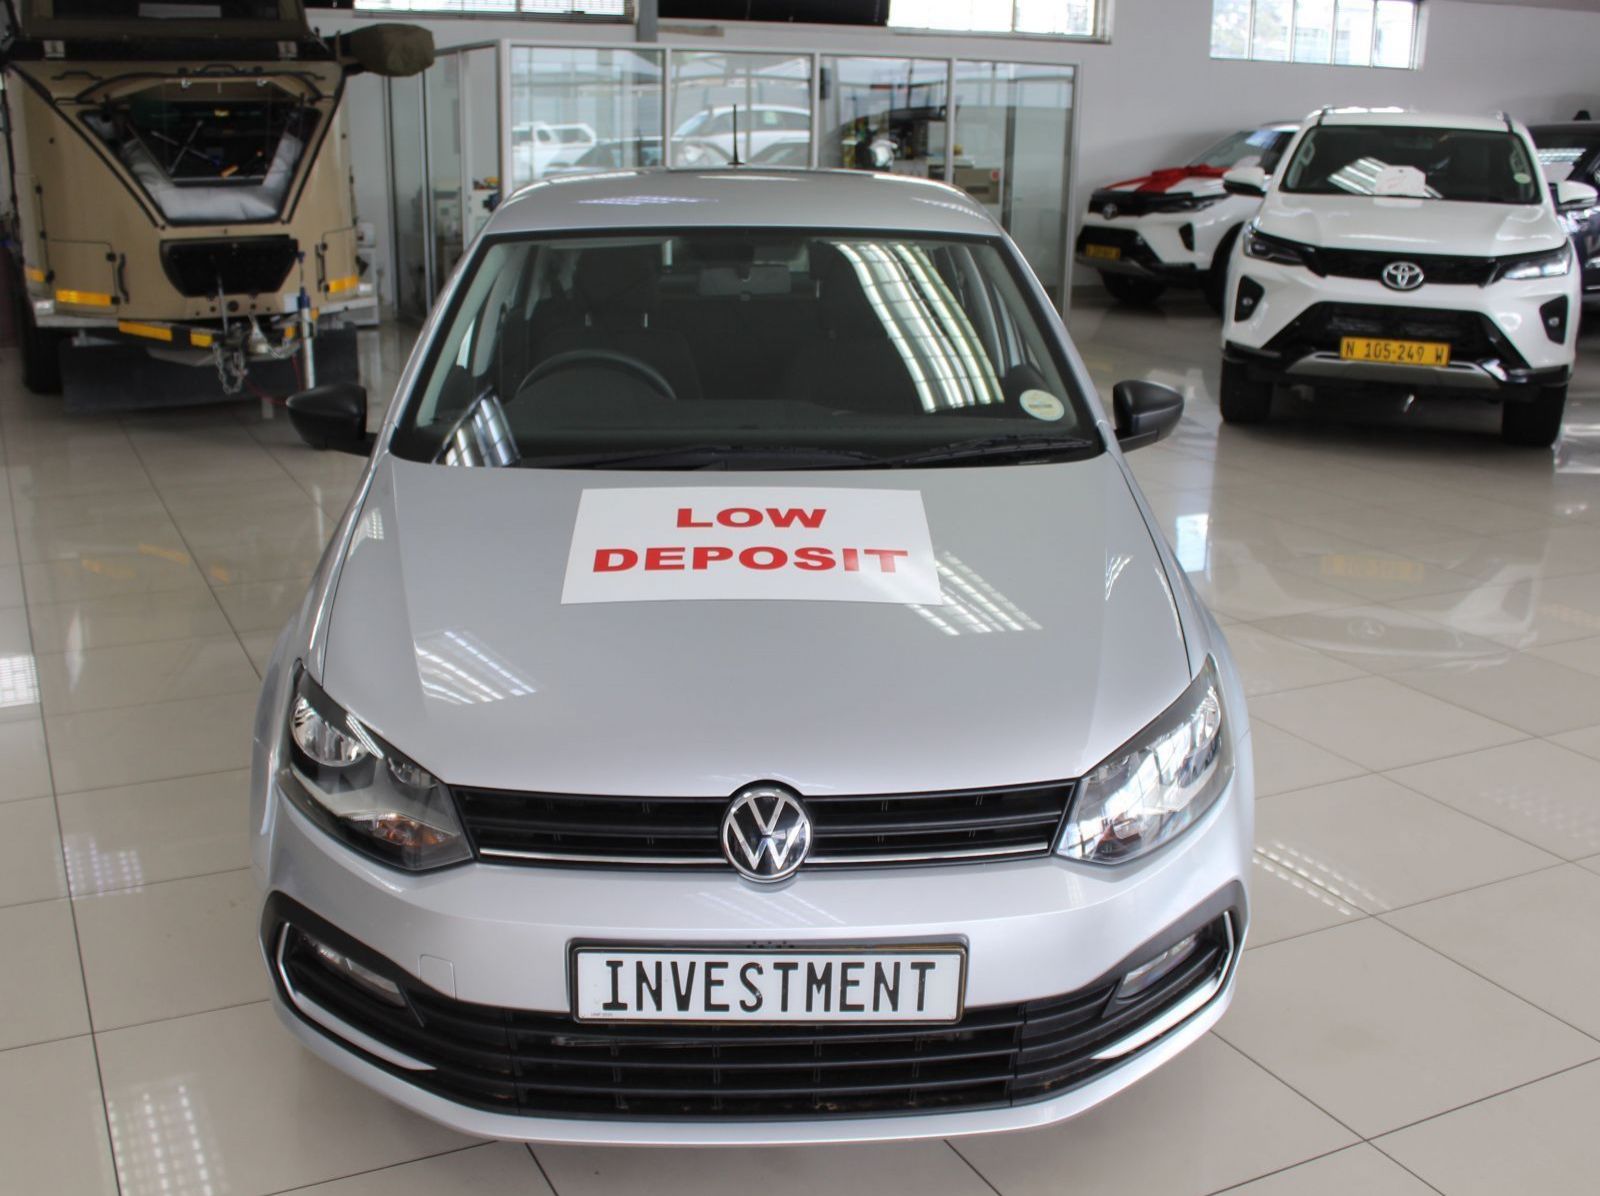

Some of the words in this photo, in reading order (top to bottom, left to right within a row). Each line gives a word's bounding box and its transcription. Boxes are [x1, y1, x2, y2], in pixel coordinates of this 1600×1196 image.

[1345, 341, 1355, 357] N
[676, 507, 827, 529] LOW
[592, 546, 909, 574] DEPOSIT
[602, 960, 937, 1013] INVESTMENT
